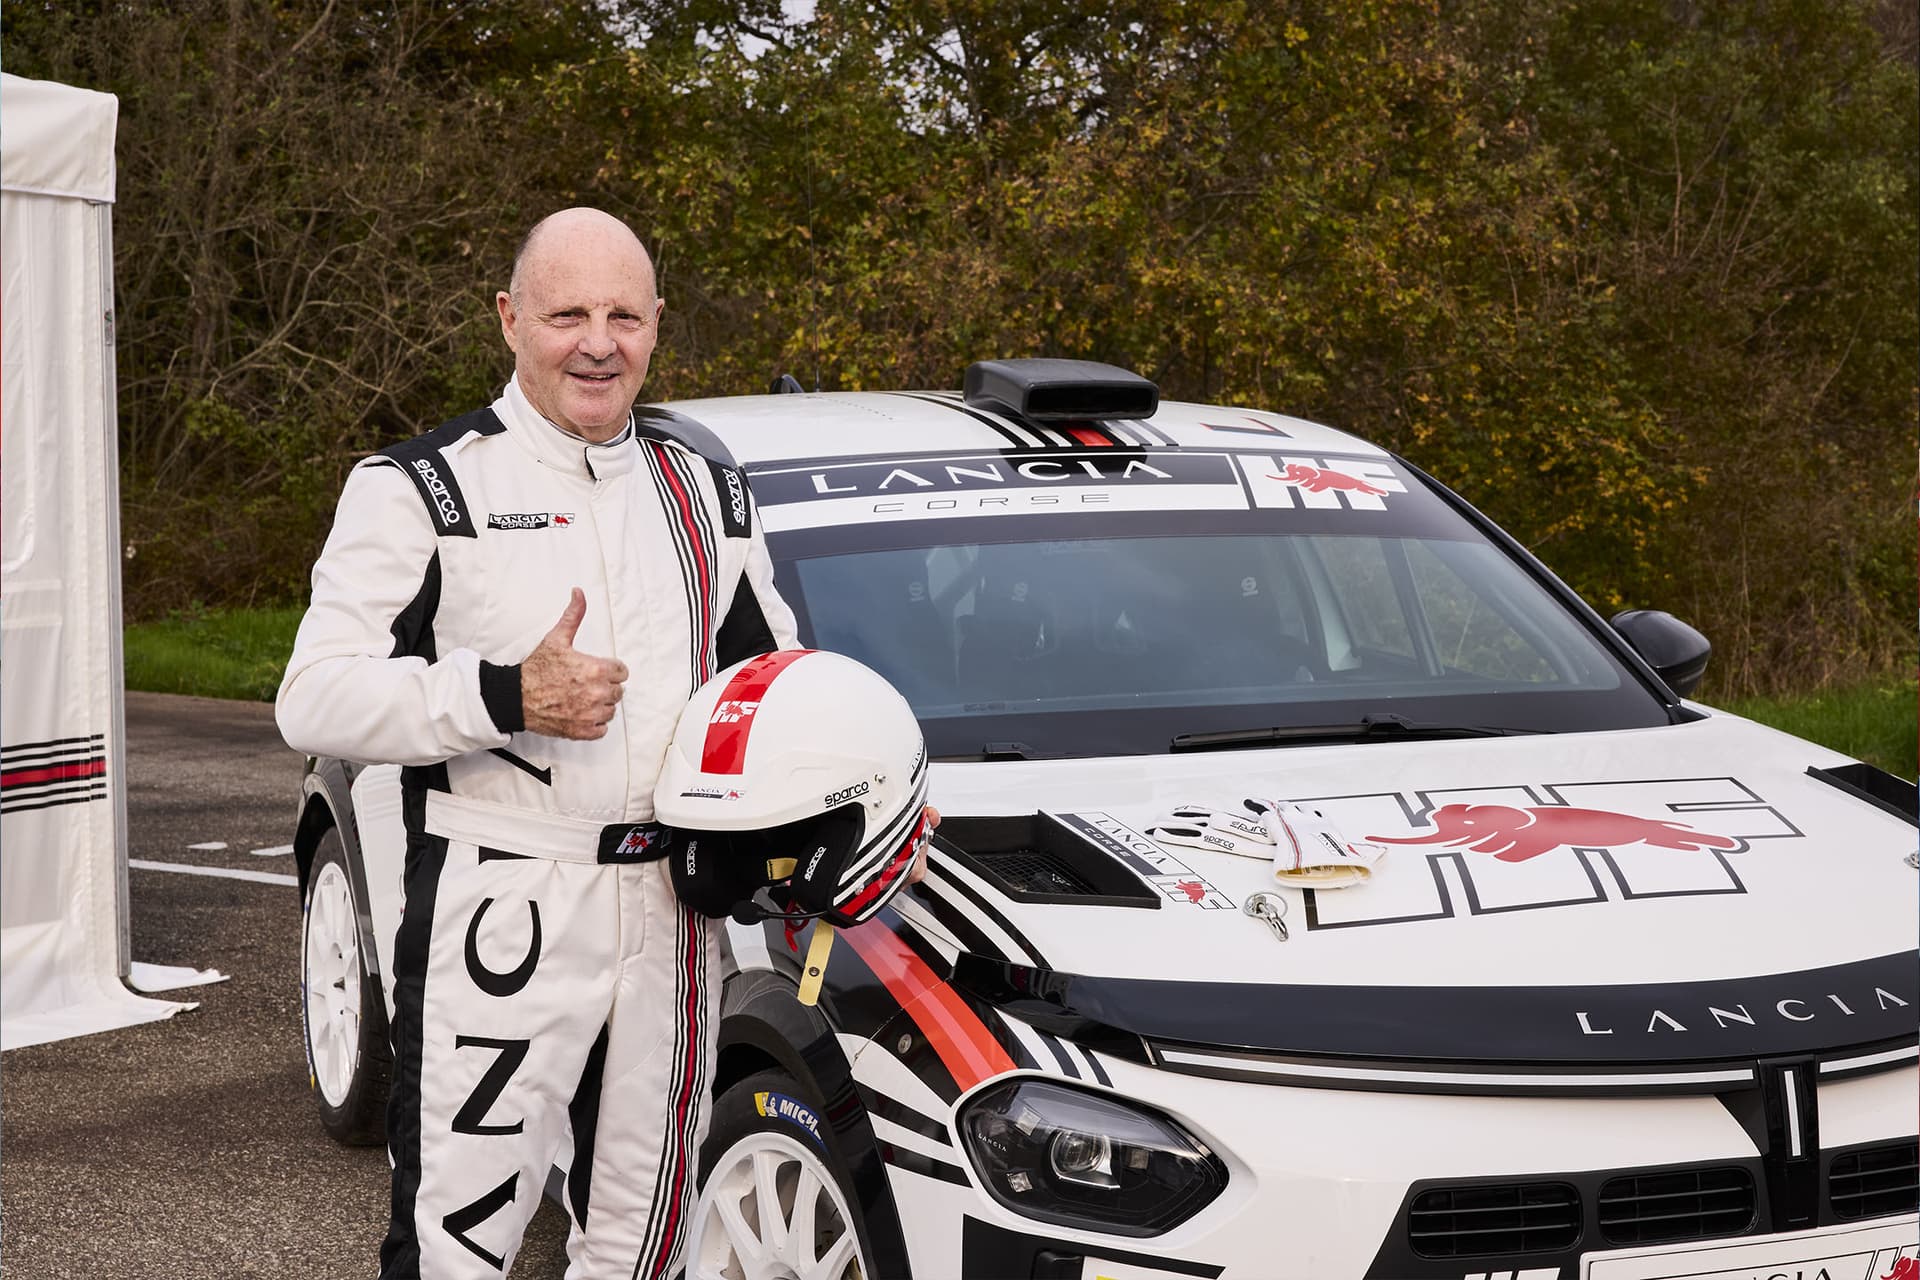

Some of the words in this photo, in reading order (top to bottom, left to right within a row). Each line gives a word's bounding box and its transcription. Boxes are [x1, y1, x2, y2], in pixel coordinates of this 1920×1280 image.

[411, 458, 461, 527] sparco
[810, 460, 1173, 494] LANCIA
[722, 468, 746, 526] sparco
[873, 493, 1111, 513] CORSE
[491, 515, 543, 524] LANCIA
[824, 781, 870, 809] sparco
[686, 840, 698, 876] sparco
[1084, 827, 1132, 858] CORSE
[1095, 819, 1167, 865] LANCIA
[1203, 834, 1236, 851] sparco
[804, 846, 827, 881] sparco
[1575, 987, 1910, 1035] LANCIA
